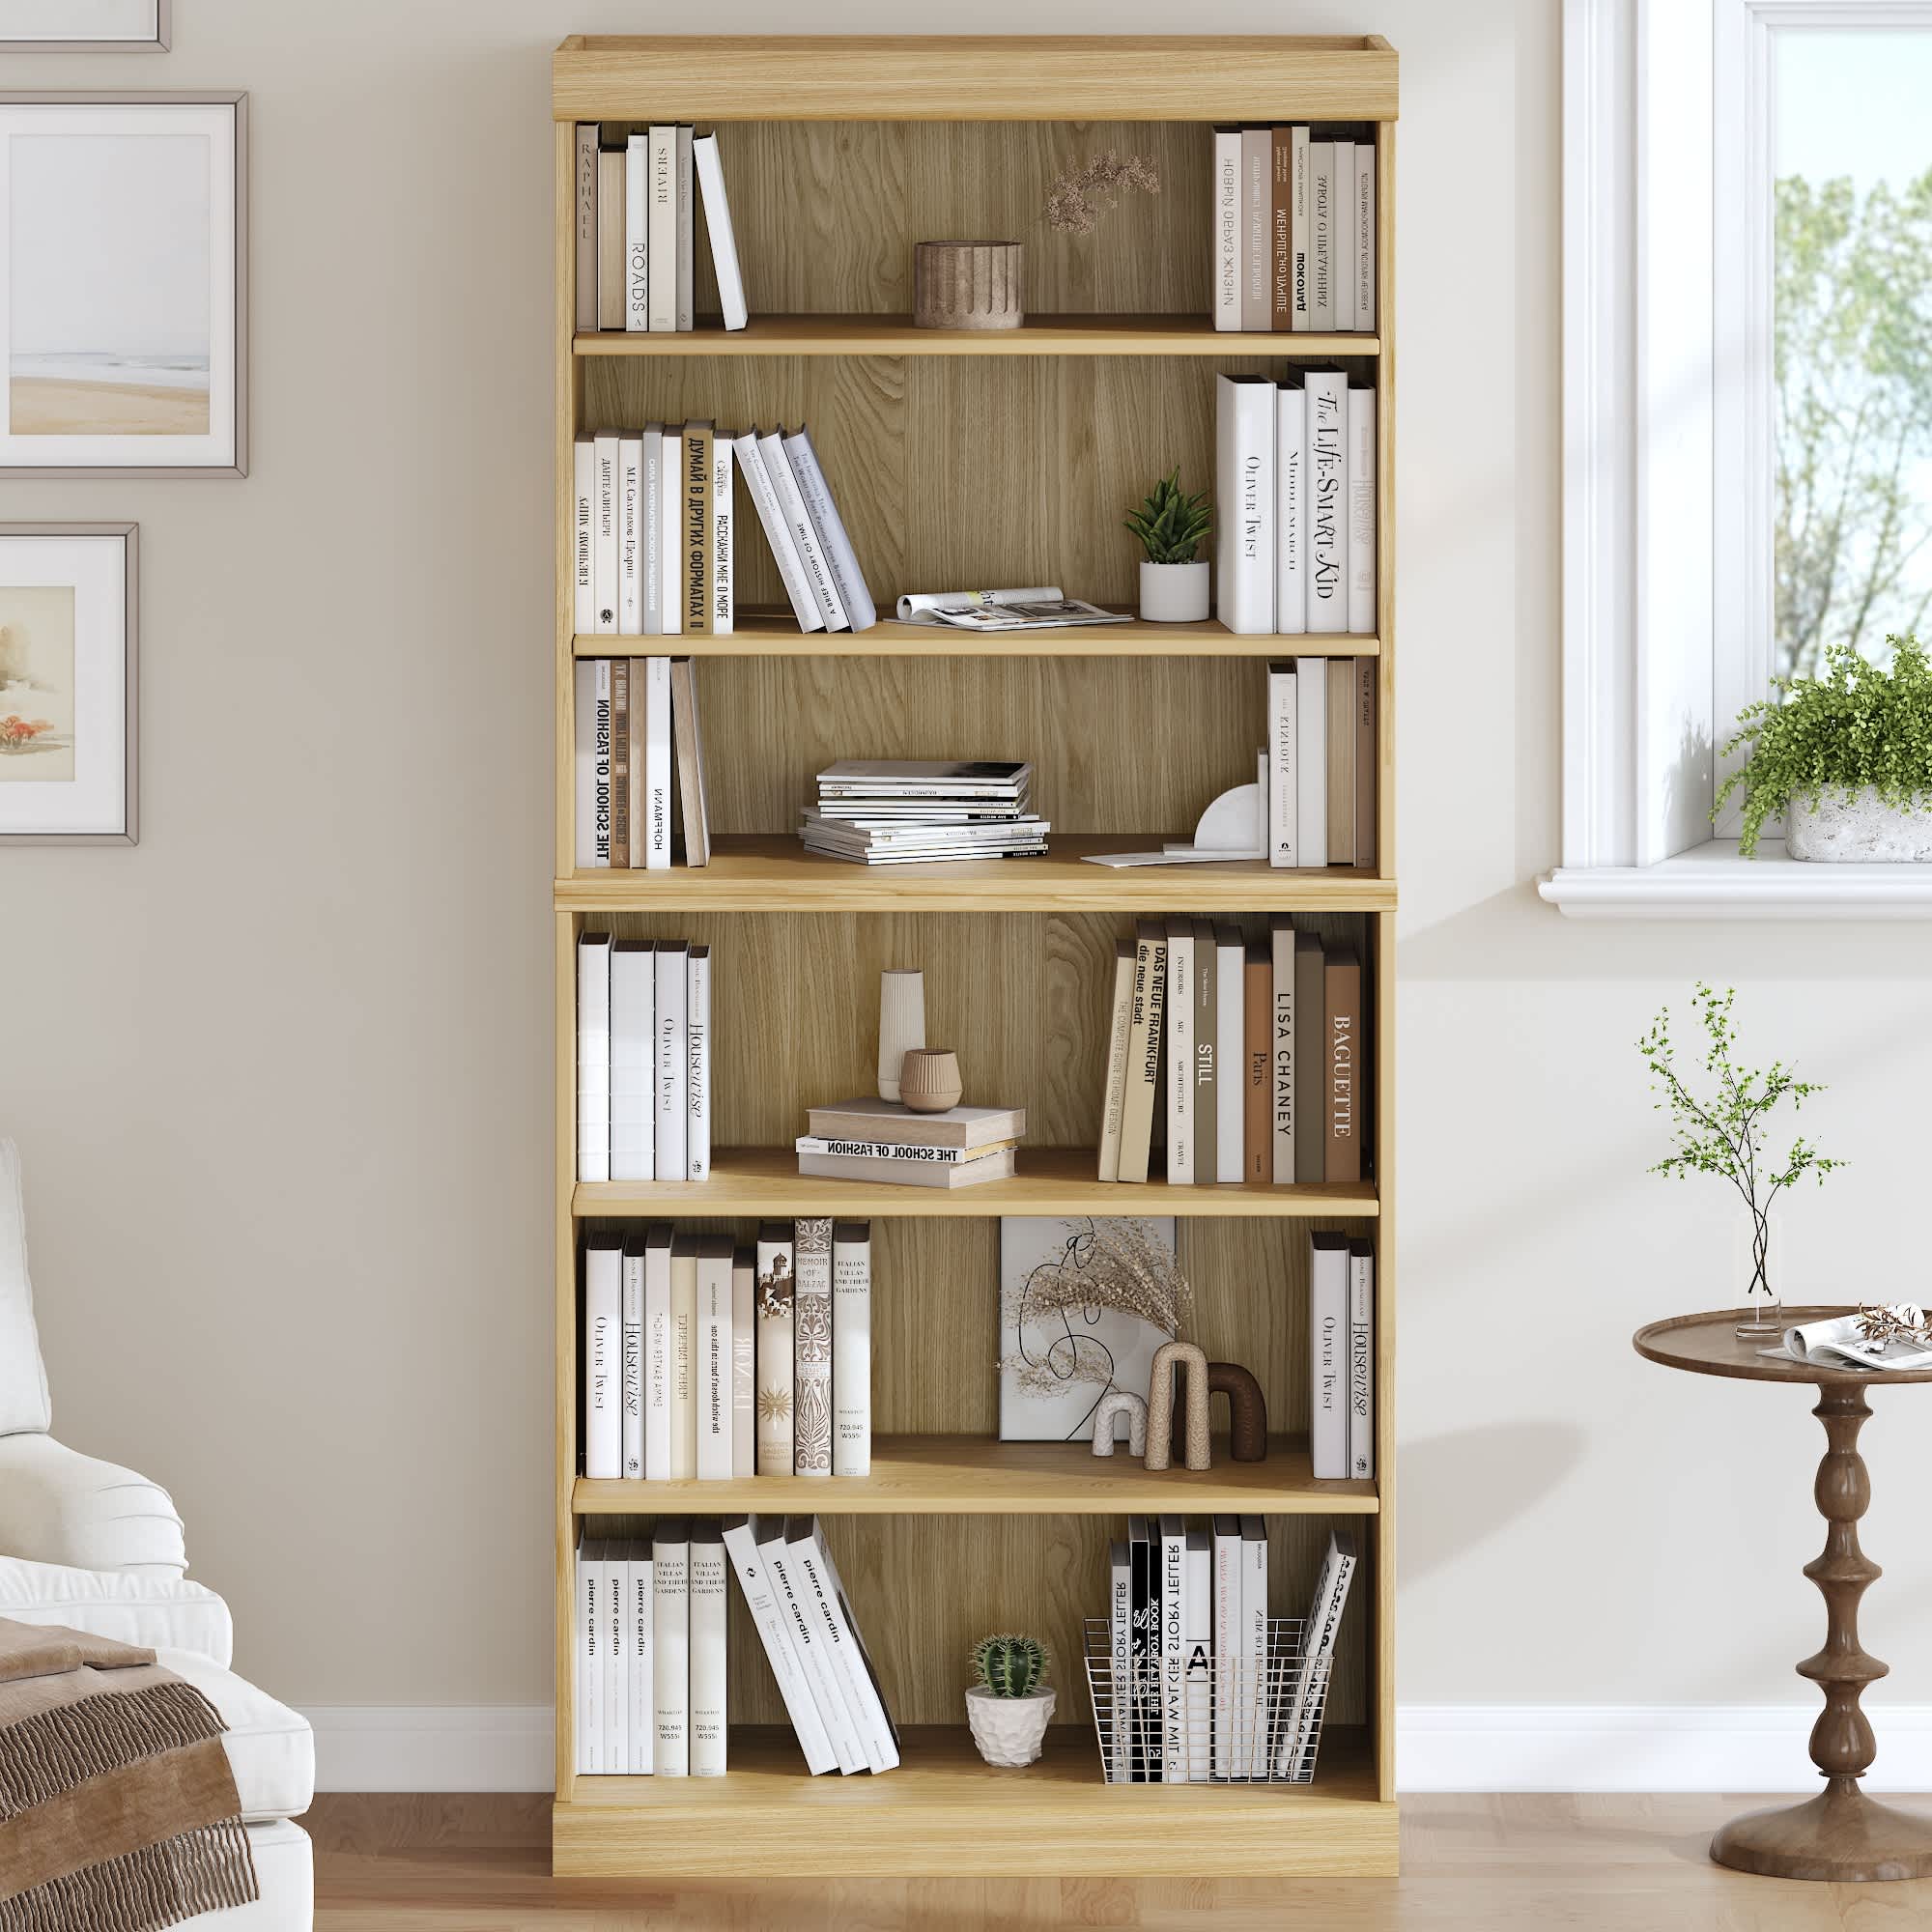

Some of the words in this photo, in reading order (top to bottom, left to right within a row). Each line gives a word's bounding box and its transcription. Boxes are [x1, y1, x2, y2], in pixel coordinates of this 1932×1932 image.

[582, 143, 592, 240] RAPHAEL
[657, 147, 668, 206] RIVERS
[632, 242, 645, 312] ROADS
[1317, 391, 1338, 425] The
[687, 437, 708, 483] ДУМАЙ
[689, 486, 704, 495] В
[579, 495, 589, 527] МИРУ
[687, 497, 704, 548] ДРУГИХ
[716, 514, 729, 562] РАССКАЖИ
[797, 523, 808, 541] TIME
[804, 542, 812, 553] OF
[579, 529, 589, 578] ВЕЧНОМУ
[810, 555, 825, 585] HISTORY
[689, 551, 705, 617] ФОРМАТАХ
[716, 565, 729, 584] МНЕ
[716, 595, 729, 620] МОРЕ
[821, 587, 834, 608] BRIEF
[1279, 716, 1291, 774] KINFOLK
[1138, 944, 1151, 964] die
[1153, 946, 1167, 974] DAS
[1136, 966, 1149, 994] neue
[1151, 975, 1164, 1010] NEUE
[1133, 997, 1145, 1027] stadt
[1277, 993, 1292, 1038] LISA
[1144, 1012, 1161, 1086] FRANKFURT
[1198, 1043, 1212, 1086] STILL
[1252, 1052, 1268, 1086] Paris
[1333, 1014, 1352, 1138] BAGUETTE
[1277, 1050, 1292, 1136] CHANEY
[1107, 1108, 1119, 1136] DESIGN
[797, 1258, 828, 1266] MEMOIR
[587, 1577, 596, 1614] pierre
[611, 1577, 620, 1614] pierre
[637, 1577, 645, 1614] pierre
[774, 1560, 794, 1599] pierre
[791, 1603, 811, 1644] cardin
[804, 1559, 823, 1599] pierre
[820, 1602, 841, 1644] cardin
[587, 1618, 596, 1656] cardin
[611, 1618, 620, 1656] cardin
[637, 1618, 645, 1656] cardin
[1186, 1645, 1209, 1677] A
